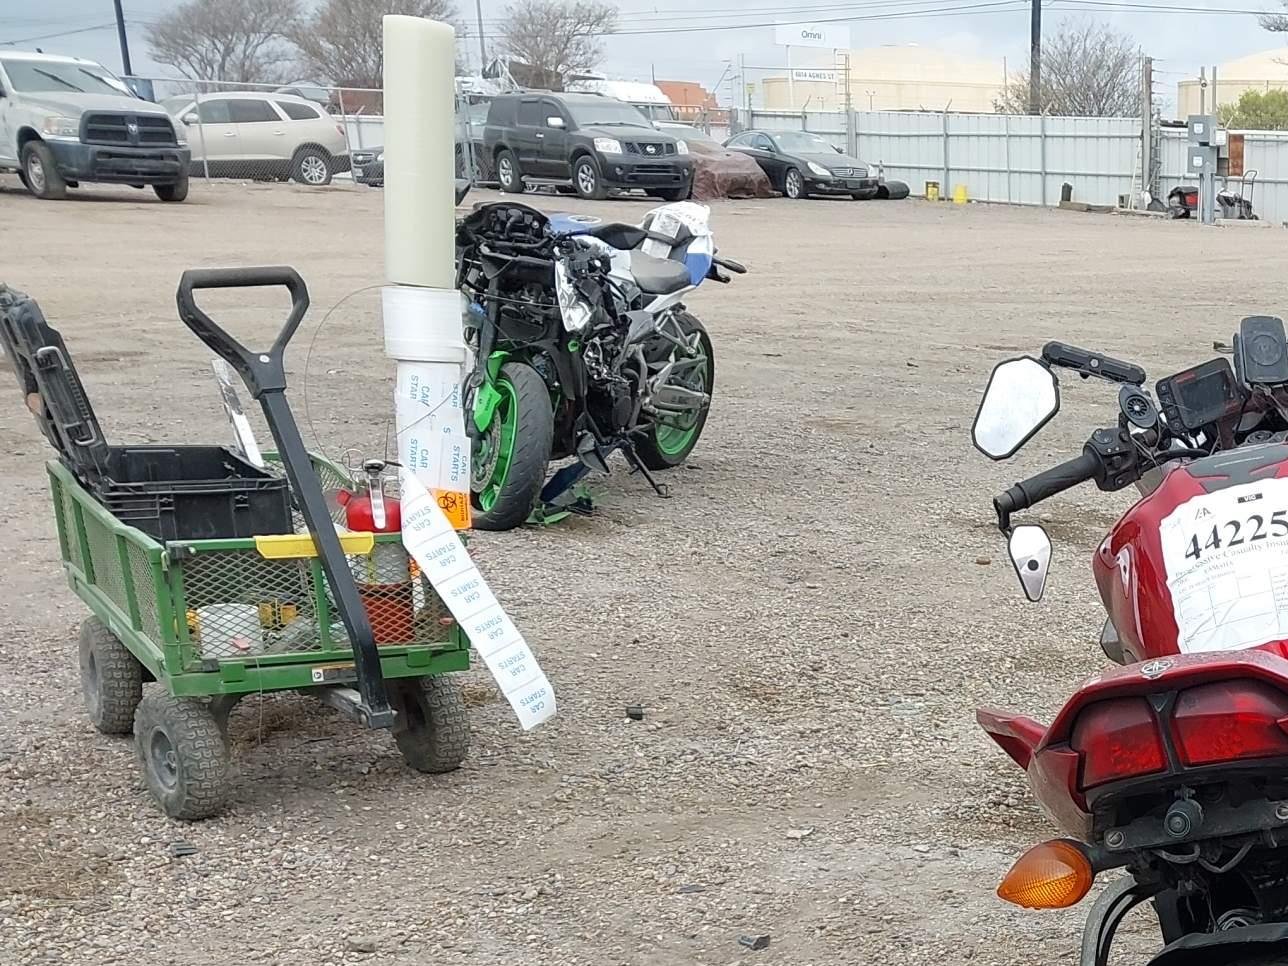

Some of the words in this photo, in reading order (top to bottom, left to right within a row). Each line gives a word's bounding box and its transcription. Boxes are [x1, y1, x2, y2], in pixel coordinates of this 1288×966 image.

[801, 30, 822, 40] Omni
[420, 448, 429, 469] CAR
[450, 444, 461, 482] STARTS
[412, 518, 431, 532] CAR
[425, 542, 457, 561] STARTS
[439, 554, 457, 567] CAR
[450, 578, 480, 597] STARTS
[463, 590, 480, 604] CAR
[474, 614, 503, 634] STARTS
[487, 627, 504, 640] CAR
[498, 650, 526, 670] STARTS
[510, 663, 527, 677] CAR
[519, 687, 547, 707] STARTS
[529, 700, 545, 714] CAR
